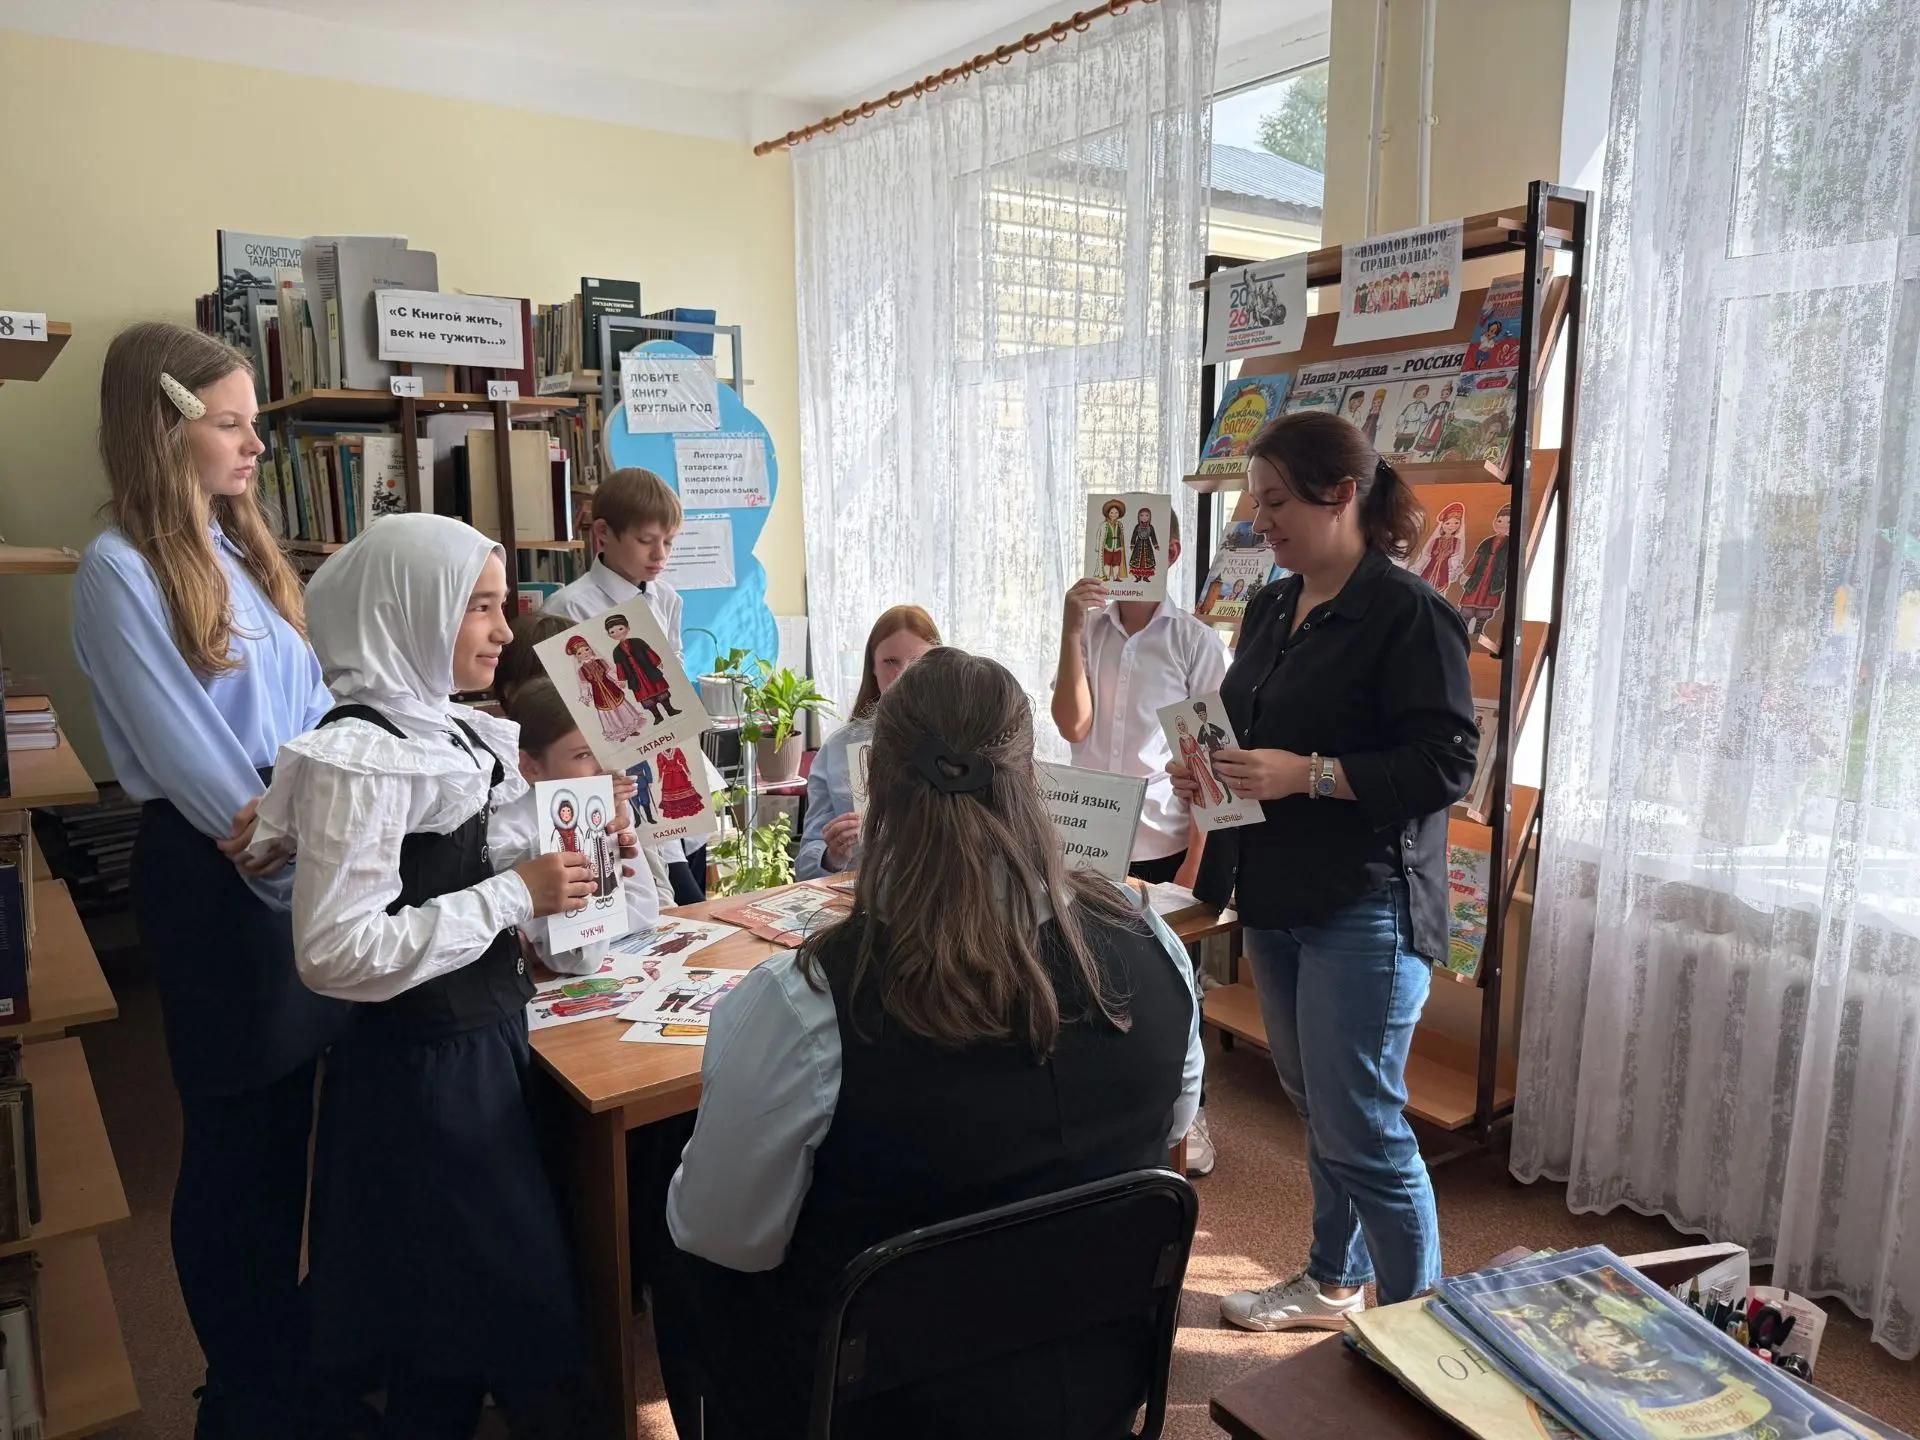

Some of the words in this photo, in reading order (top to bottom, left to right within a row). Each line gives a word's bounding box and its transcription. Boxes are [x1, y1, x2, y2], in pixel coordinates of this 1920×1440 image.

[1354, 238, 1409, 258] «НАРОДОВ
[1230, 287, 1249, 308] 20
[389, 307, 407, 317] «С
[412, 307, 461, 322] Книгой
[465, 315, 503, 328] жить,
[1229, 307, 1250, 328] 26
[390, 328, 414, 338] век
[419, 331, 436, 340] не
[440, 333, 506, 346] тужить...»
[1300, 371, 1337, 386] Наша
[1337, 365, 1388, 383] родина
[1402, 353, 1465, 373] РОССИЯ
[630, 373, 680, 383] ЛЮБИТЕ
[632, 388, 668, 398] КНИГУ
[633, 402, 687, 414] КРУГЛЫЙ
[690, 403, 713, 414] ГОД
[1223, 418, 1259, 434] РОССИИ
[693, 451, 743, 461] Литература
[684, 464, 728, 472] татарских
[1206, 462, 1242, 474] КУЛЬТУРА
[685, 475, 731, 483] писателей
[686, 487, 731, 495] татарском
[732, 486, 759, 494] языке
[1222, 567, 1259, 575] РОССИИ
[636, 732, 676, 755] ТАТАРЫ
[1081, 795, 1121, 813] язык,
[1051, 813, 1087, 829] ивая
[653, 826, 687, 839] КАЗАКИ
[580, 924, 605, 938] ЧУКЧИ
